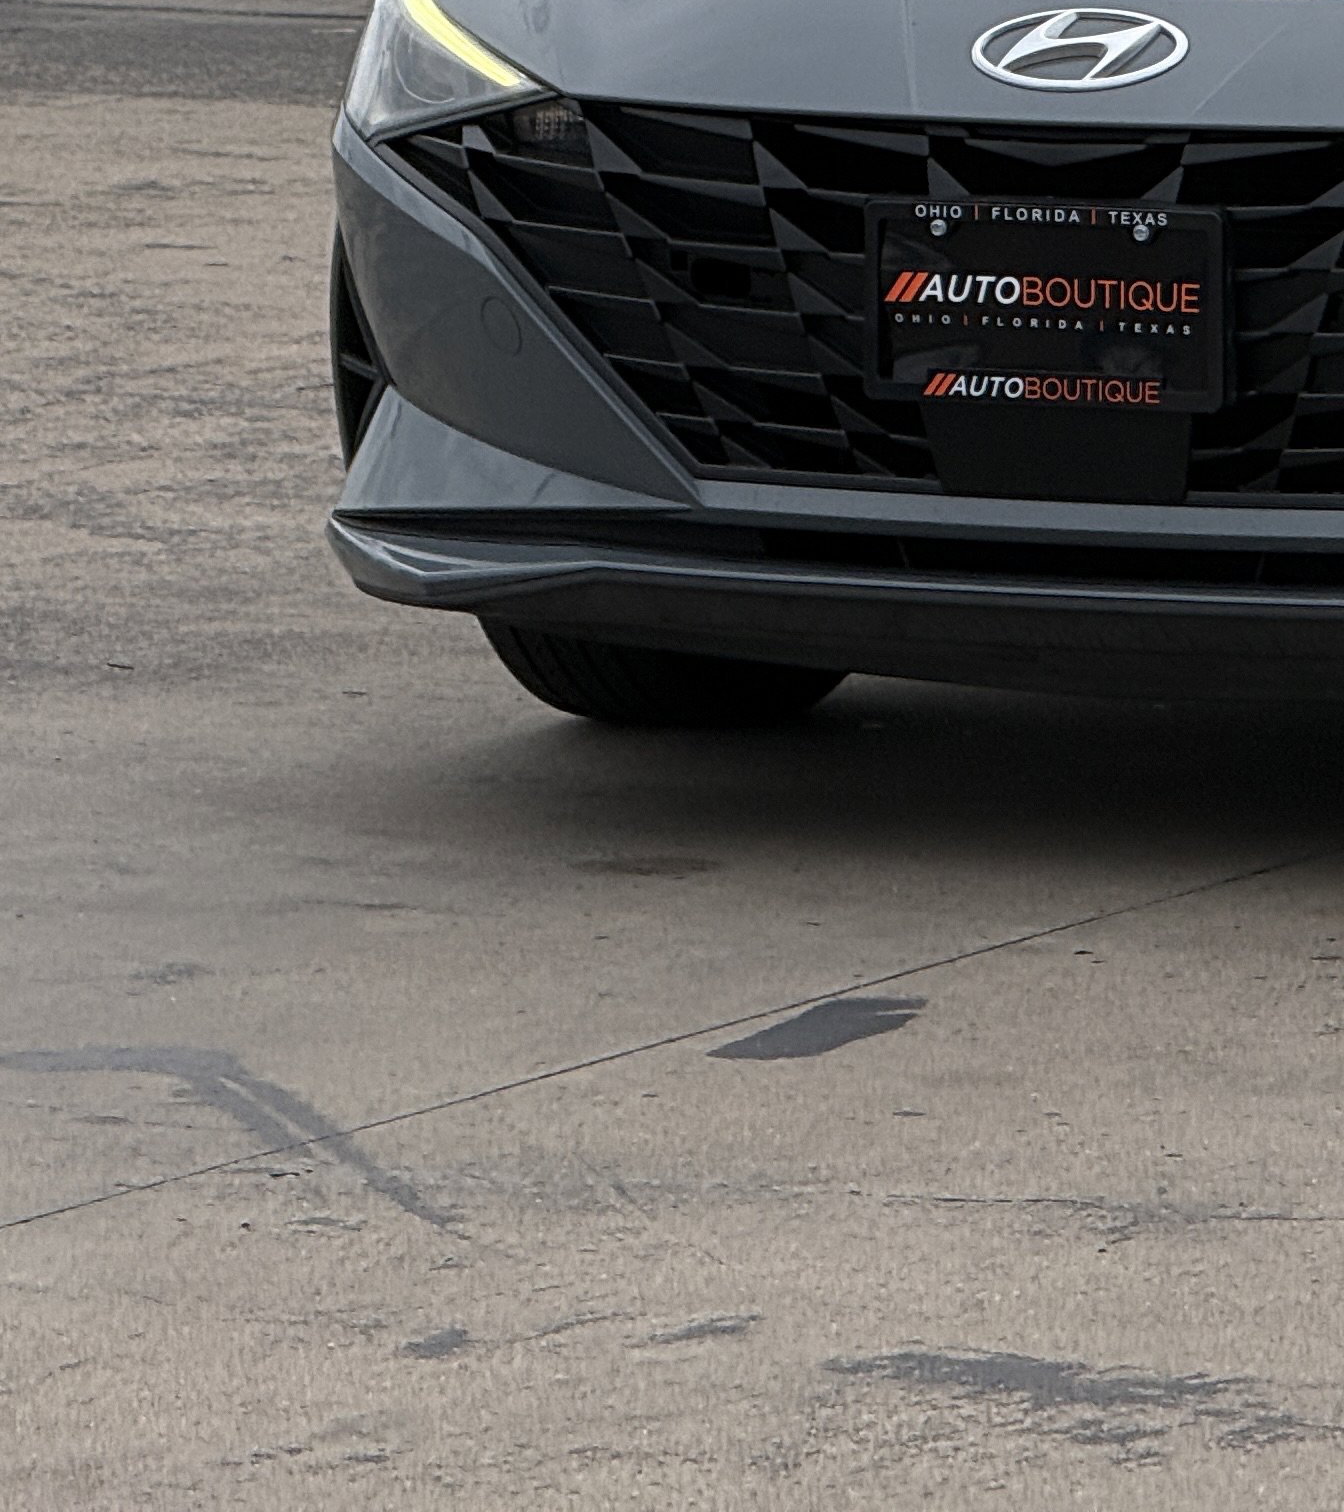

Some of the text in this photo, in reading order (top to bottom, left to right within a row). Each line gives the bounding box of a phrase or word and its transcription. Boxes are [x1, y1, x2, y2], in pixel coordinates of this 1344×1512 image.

[914, 204, 1169, 226] OHIO FLORIDA TEXAS
[894, 313, 1193, 336] OHIO FLORIDA TEXAS
